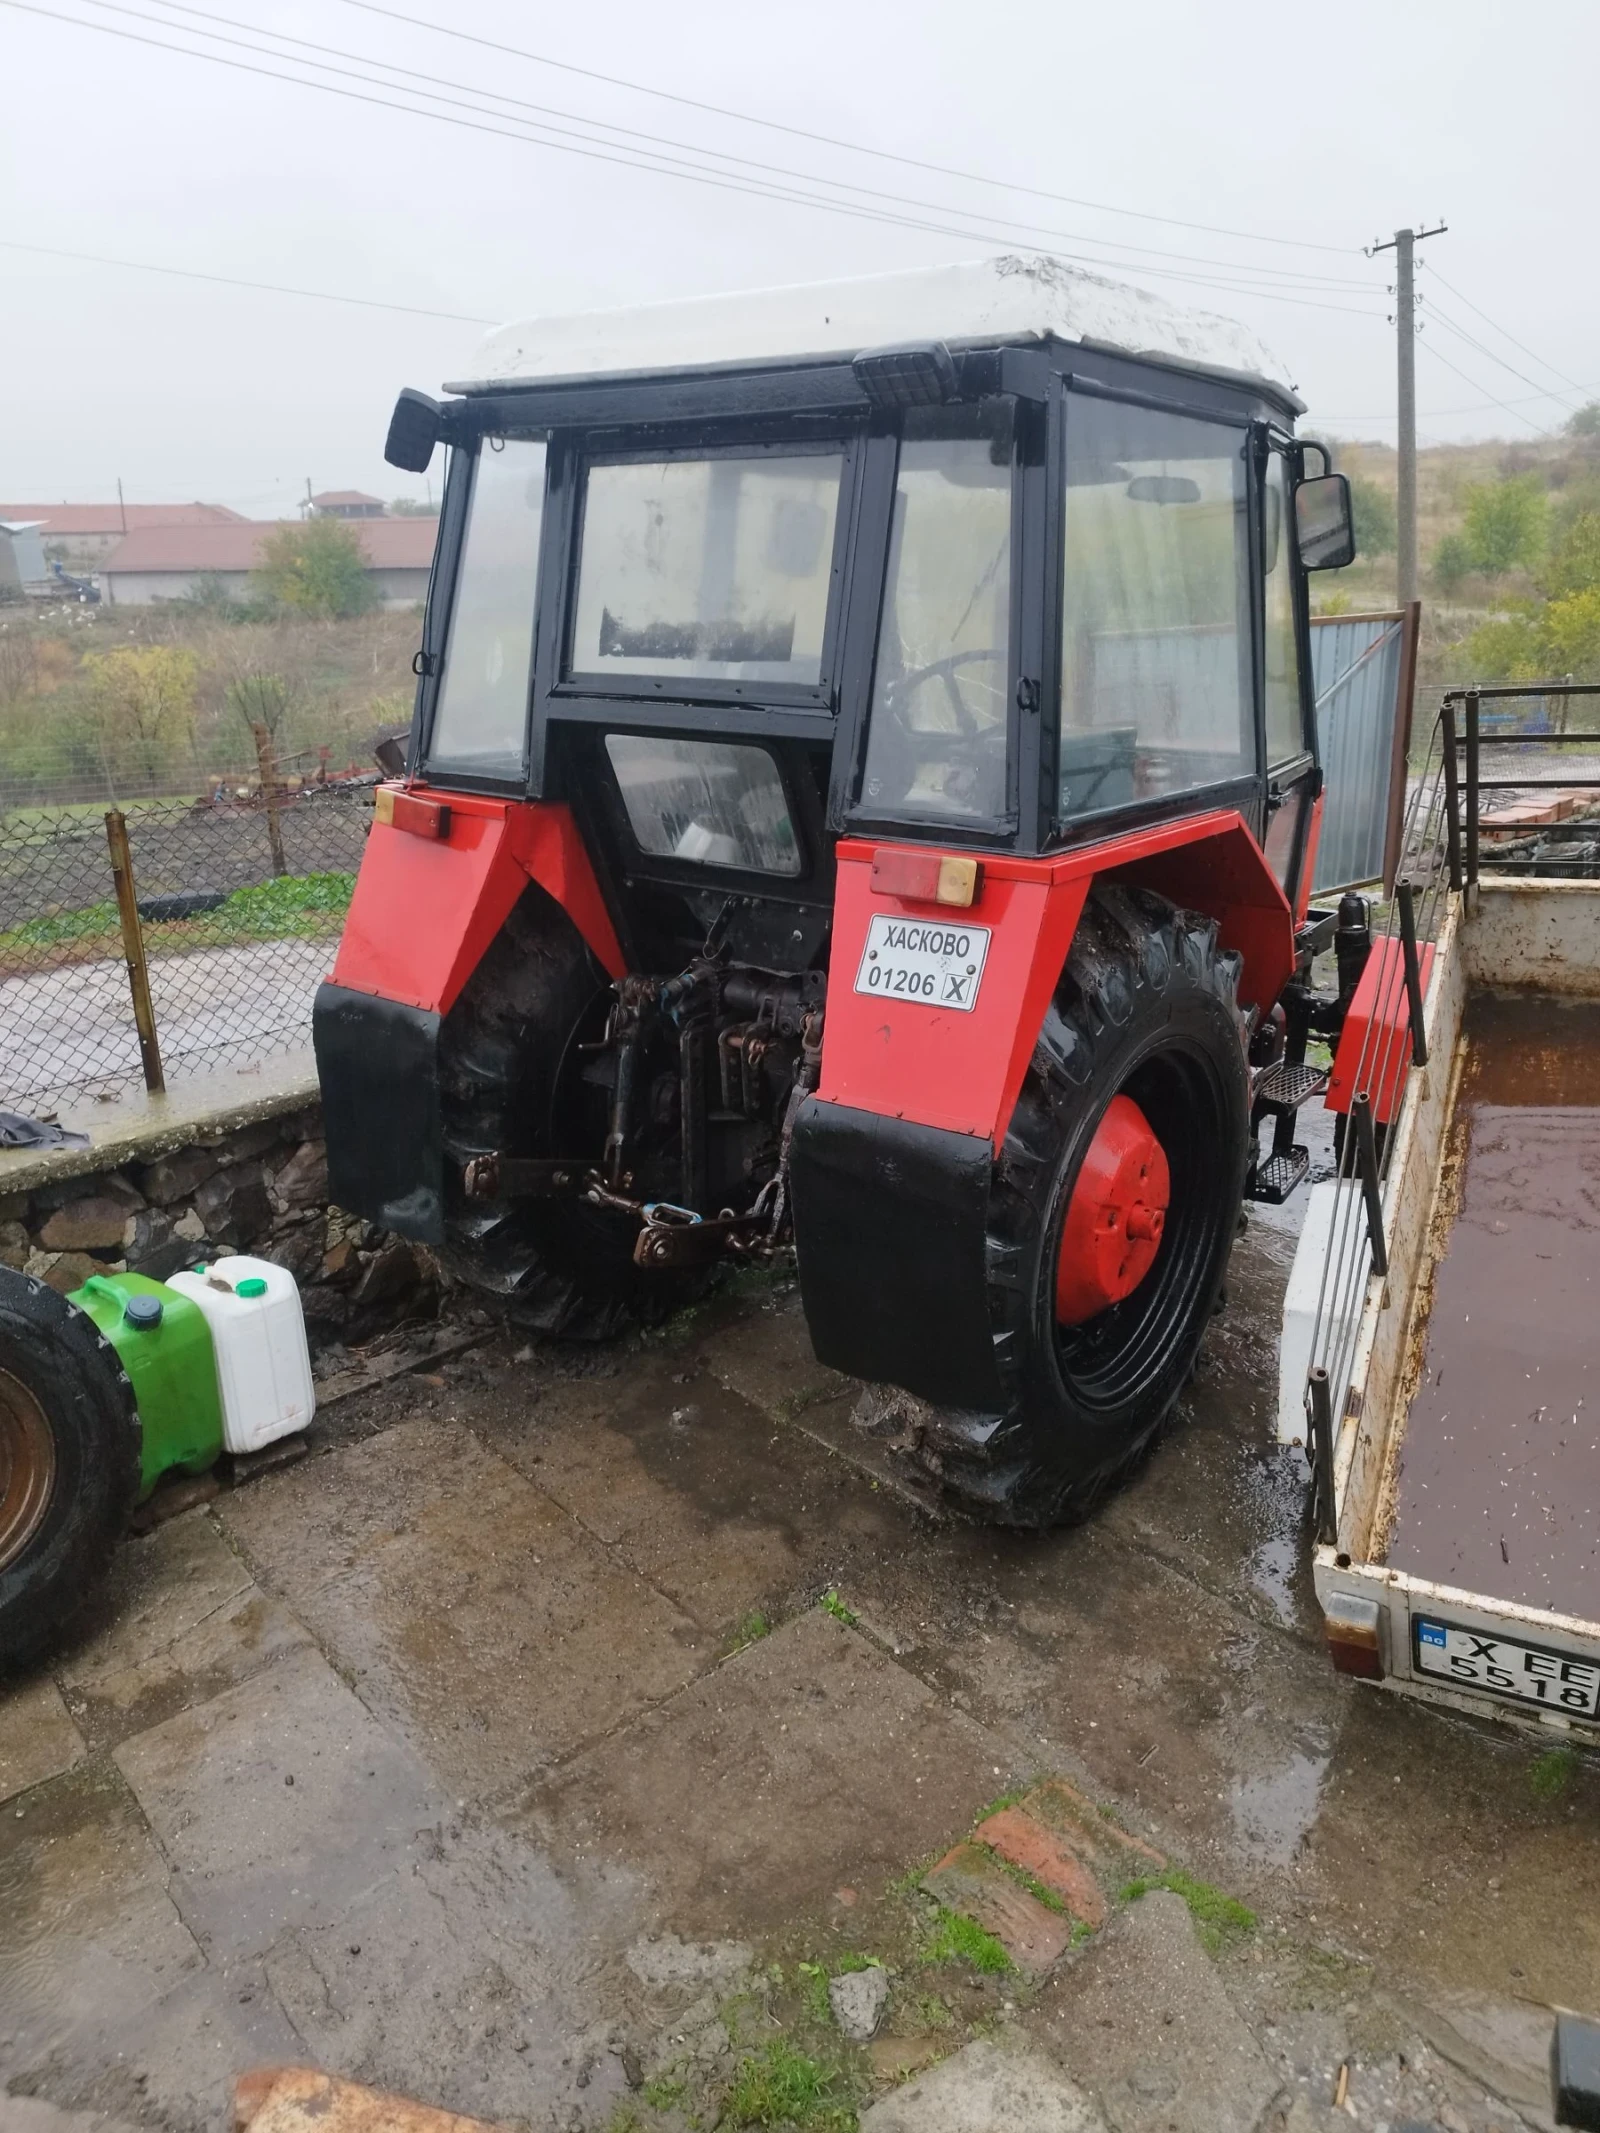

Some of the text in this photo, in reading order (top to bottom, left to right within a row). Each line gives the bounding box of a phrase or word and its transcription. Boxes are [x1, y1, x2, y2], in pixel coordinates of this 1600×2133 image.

[883, 925, 970, 958] ХАСКОВО
[868, 966, 936, 996] 01206
[1423, 1634, 1444, 1645] BG
[1450, 1655, 1590, 1708] 5518
[1524, 1652, 1594, 1689] EE
